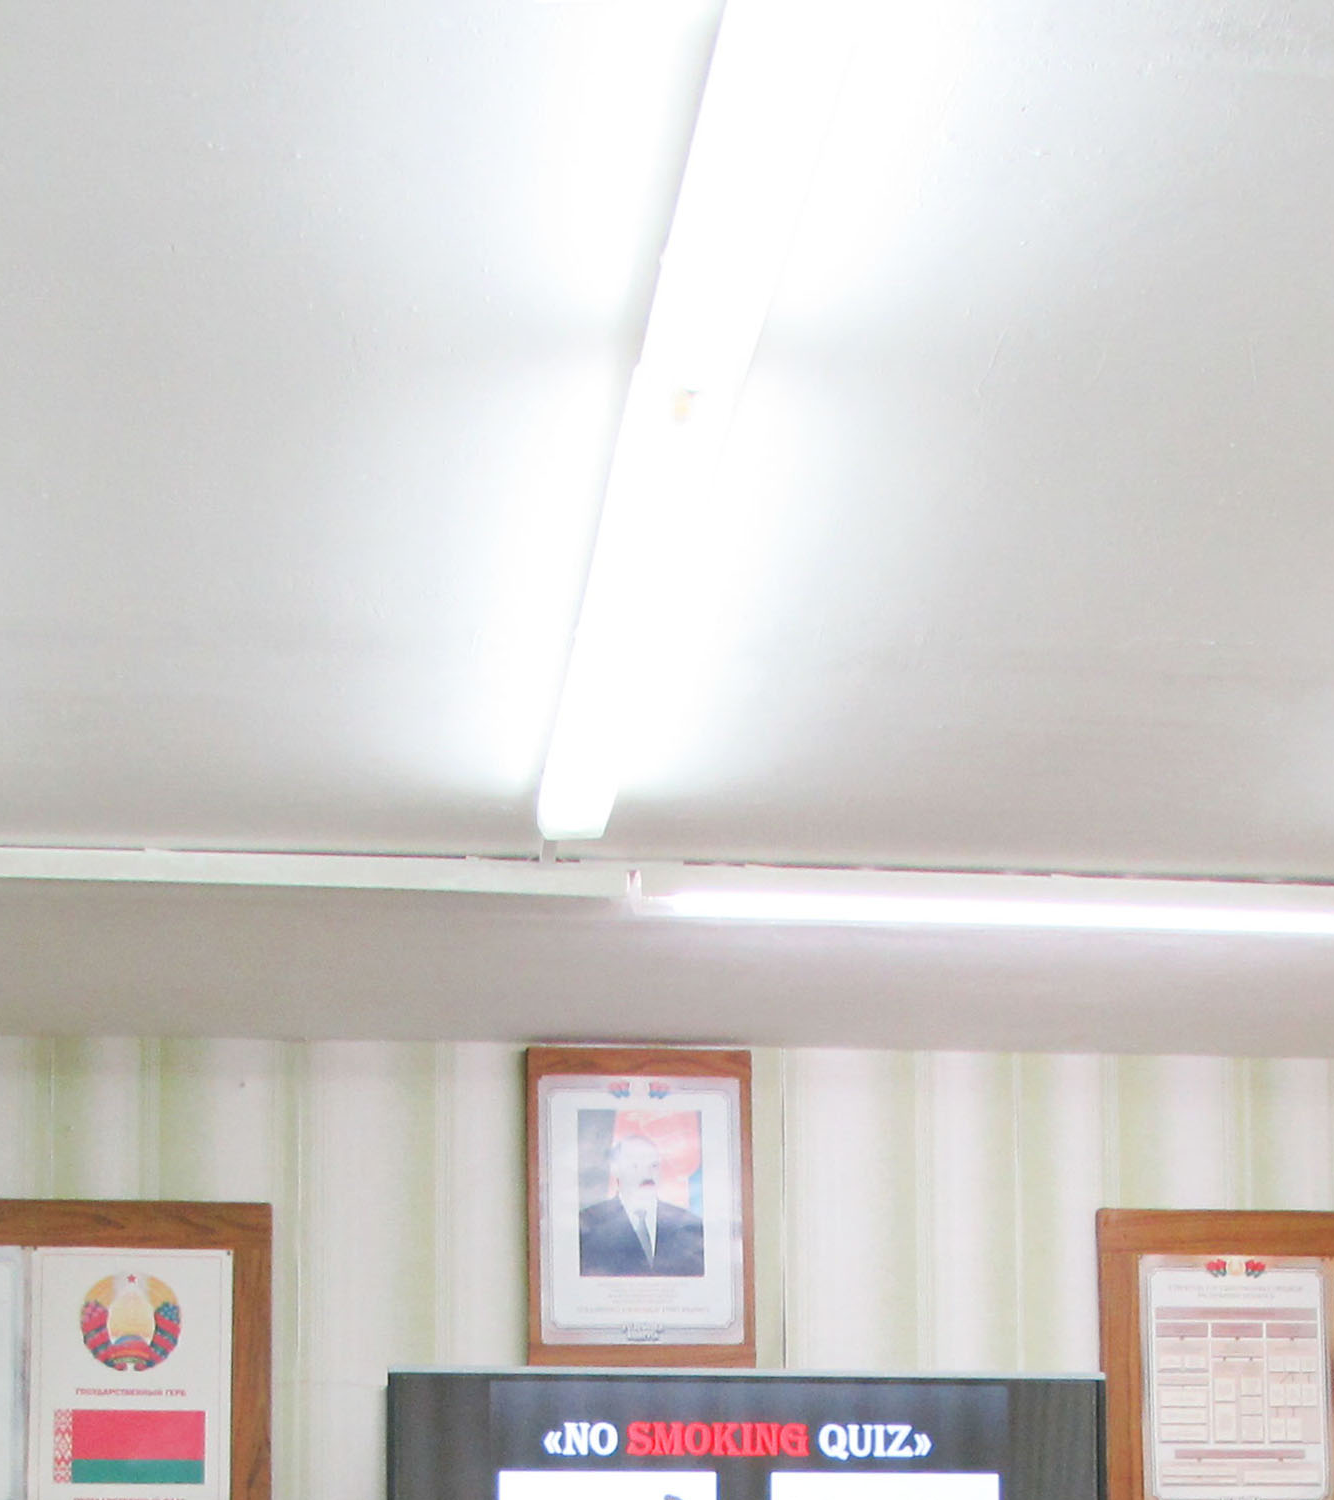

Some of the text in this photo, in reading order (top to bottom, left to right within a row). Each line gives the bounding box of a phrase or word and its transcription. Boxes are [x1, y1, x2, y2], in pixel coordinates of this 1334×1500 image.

[543, 1420, 933, 1461] «NO SMOKING QUIZ»
